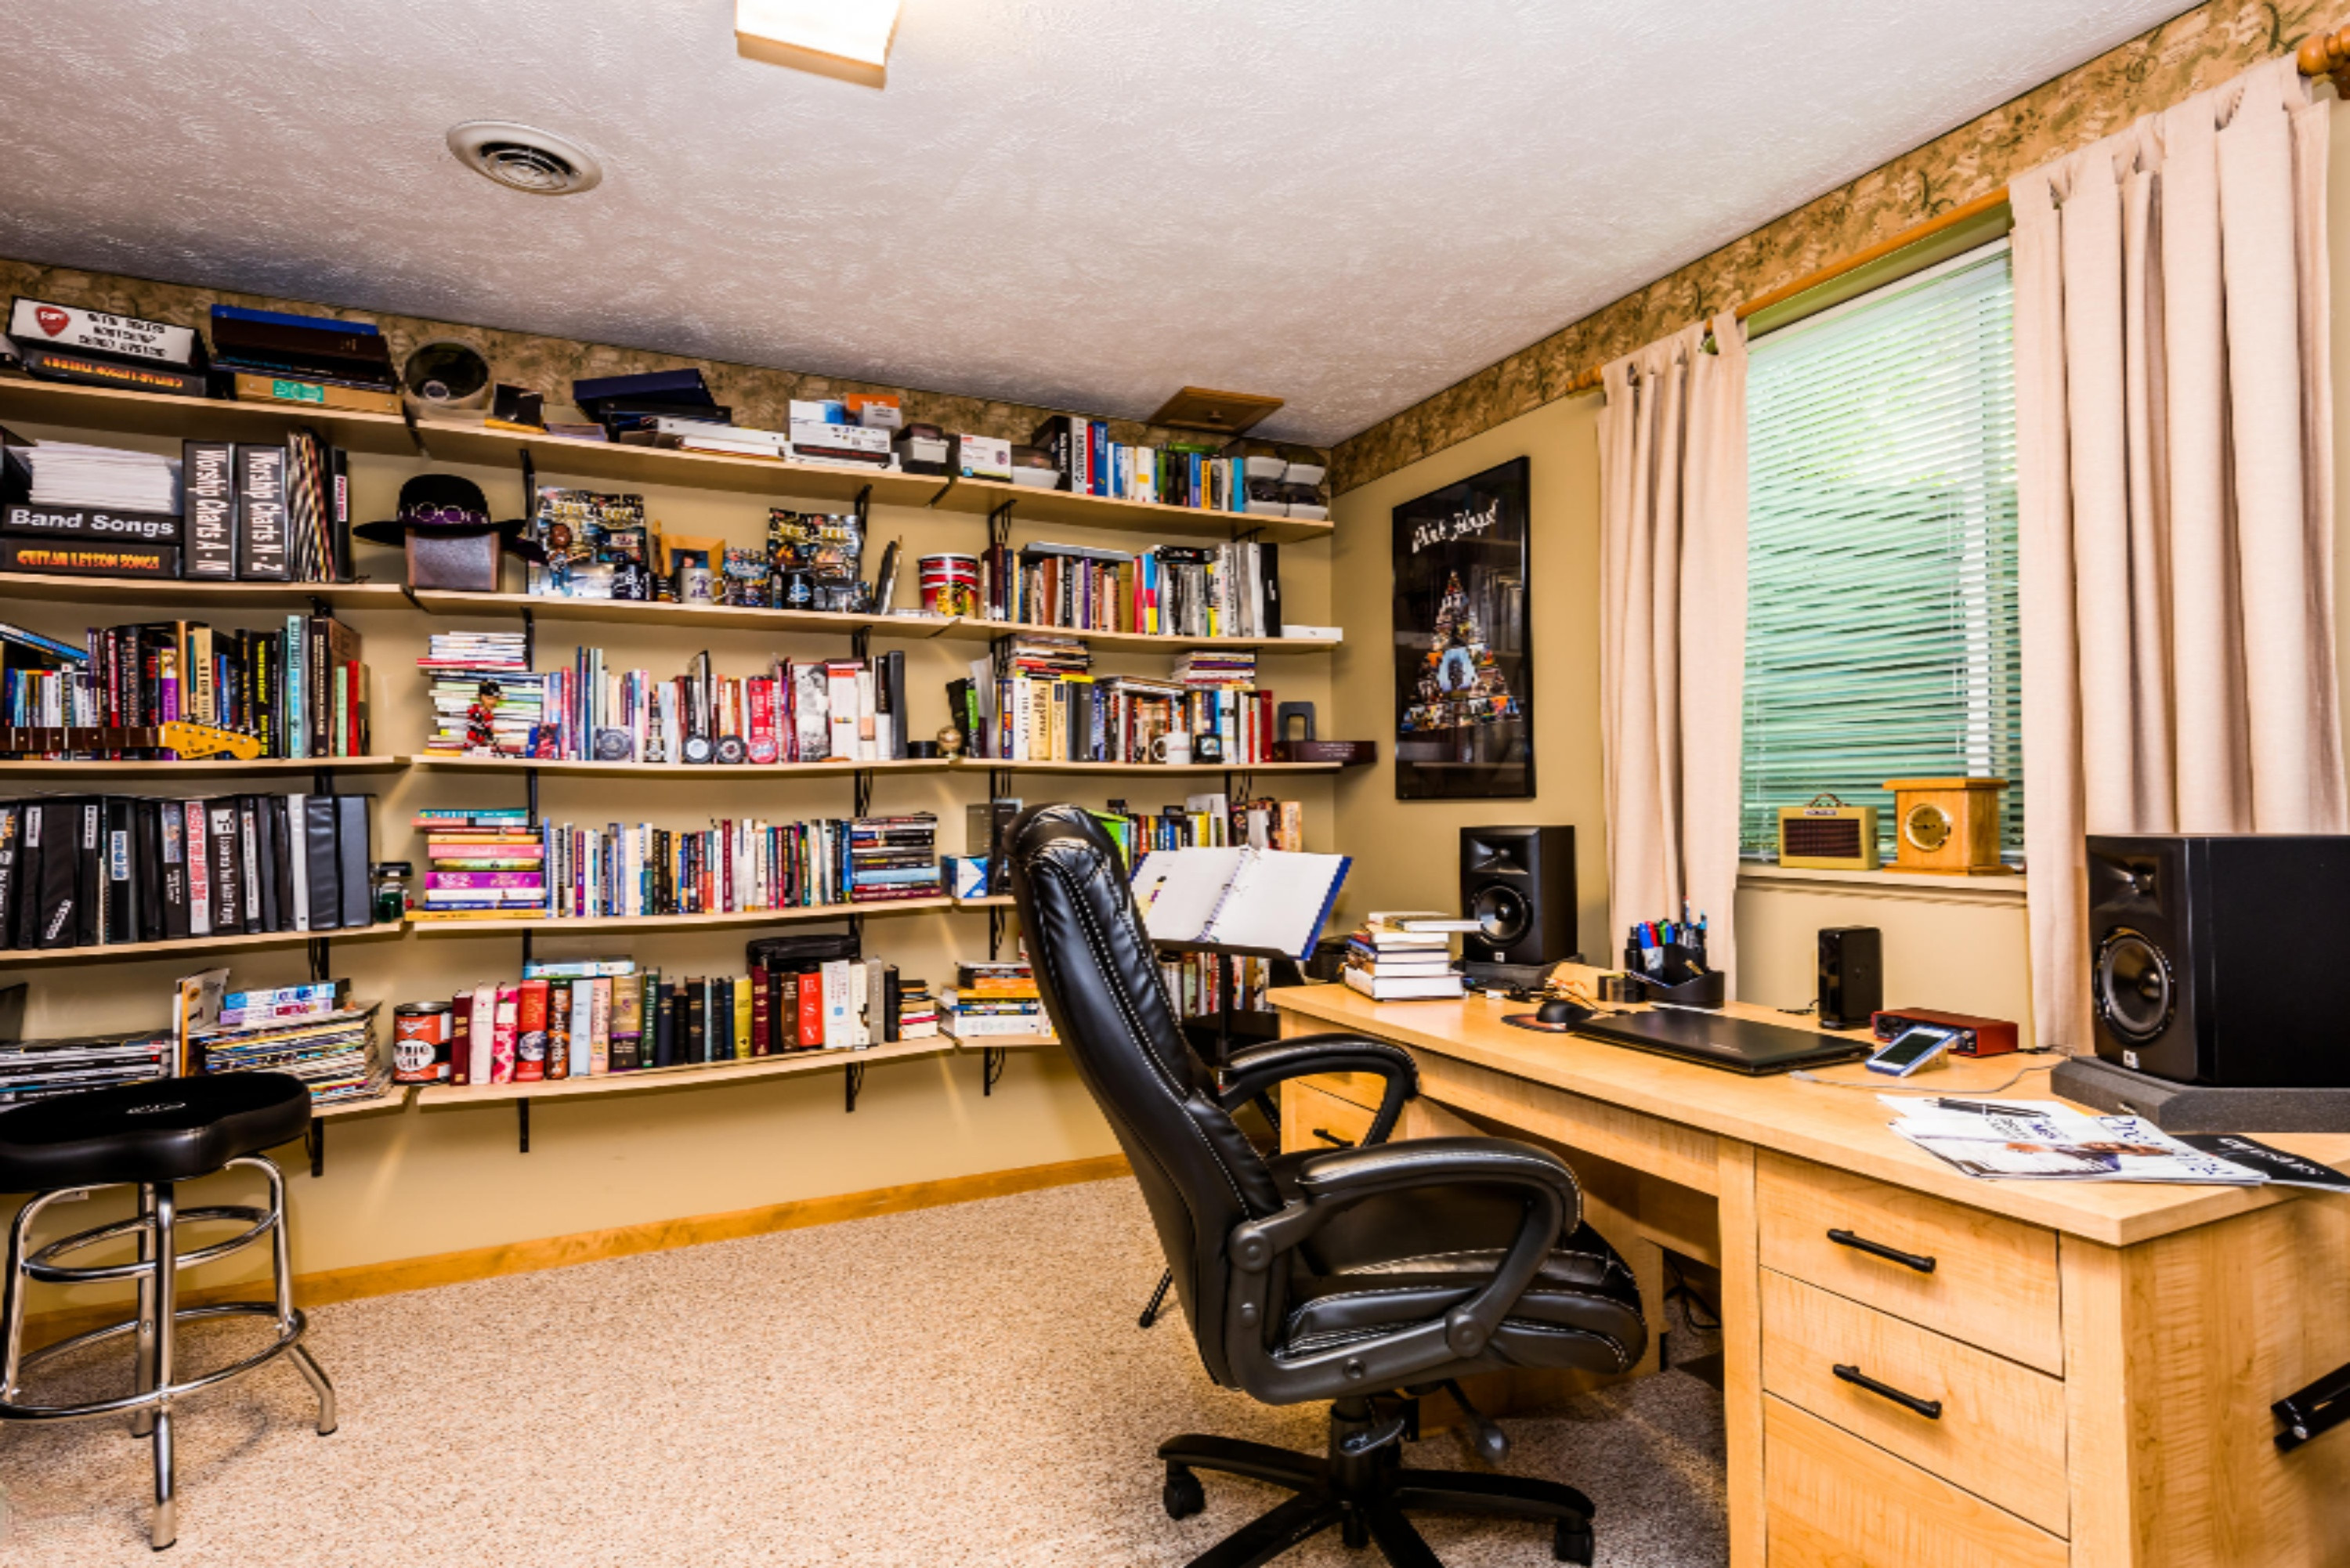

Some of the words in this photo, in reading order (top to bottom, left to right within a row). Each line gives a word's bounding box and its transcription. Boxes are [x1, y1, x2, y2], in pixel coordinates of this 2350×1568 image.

[186, 450, 226, 497] Worship
[240, 451, 280, 499] Worship
[10, 508, 83, 529] Band
[91, 514, 175, 538] Songs
[196, 500, 230, 538] Charts
[249, 501, 283, 540] Charts
[16, 549, 68, 567] GUITAR
[70, 551, 118, 568] LESSON
[120, 554, 160, 569] SONGS
[195, 540, 230, 551] A
[251, 544, 284, 554] N
[251, 562, 283, 572] Z
